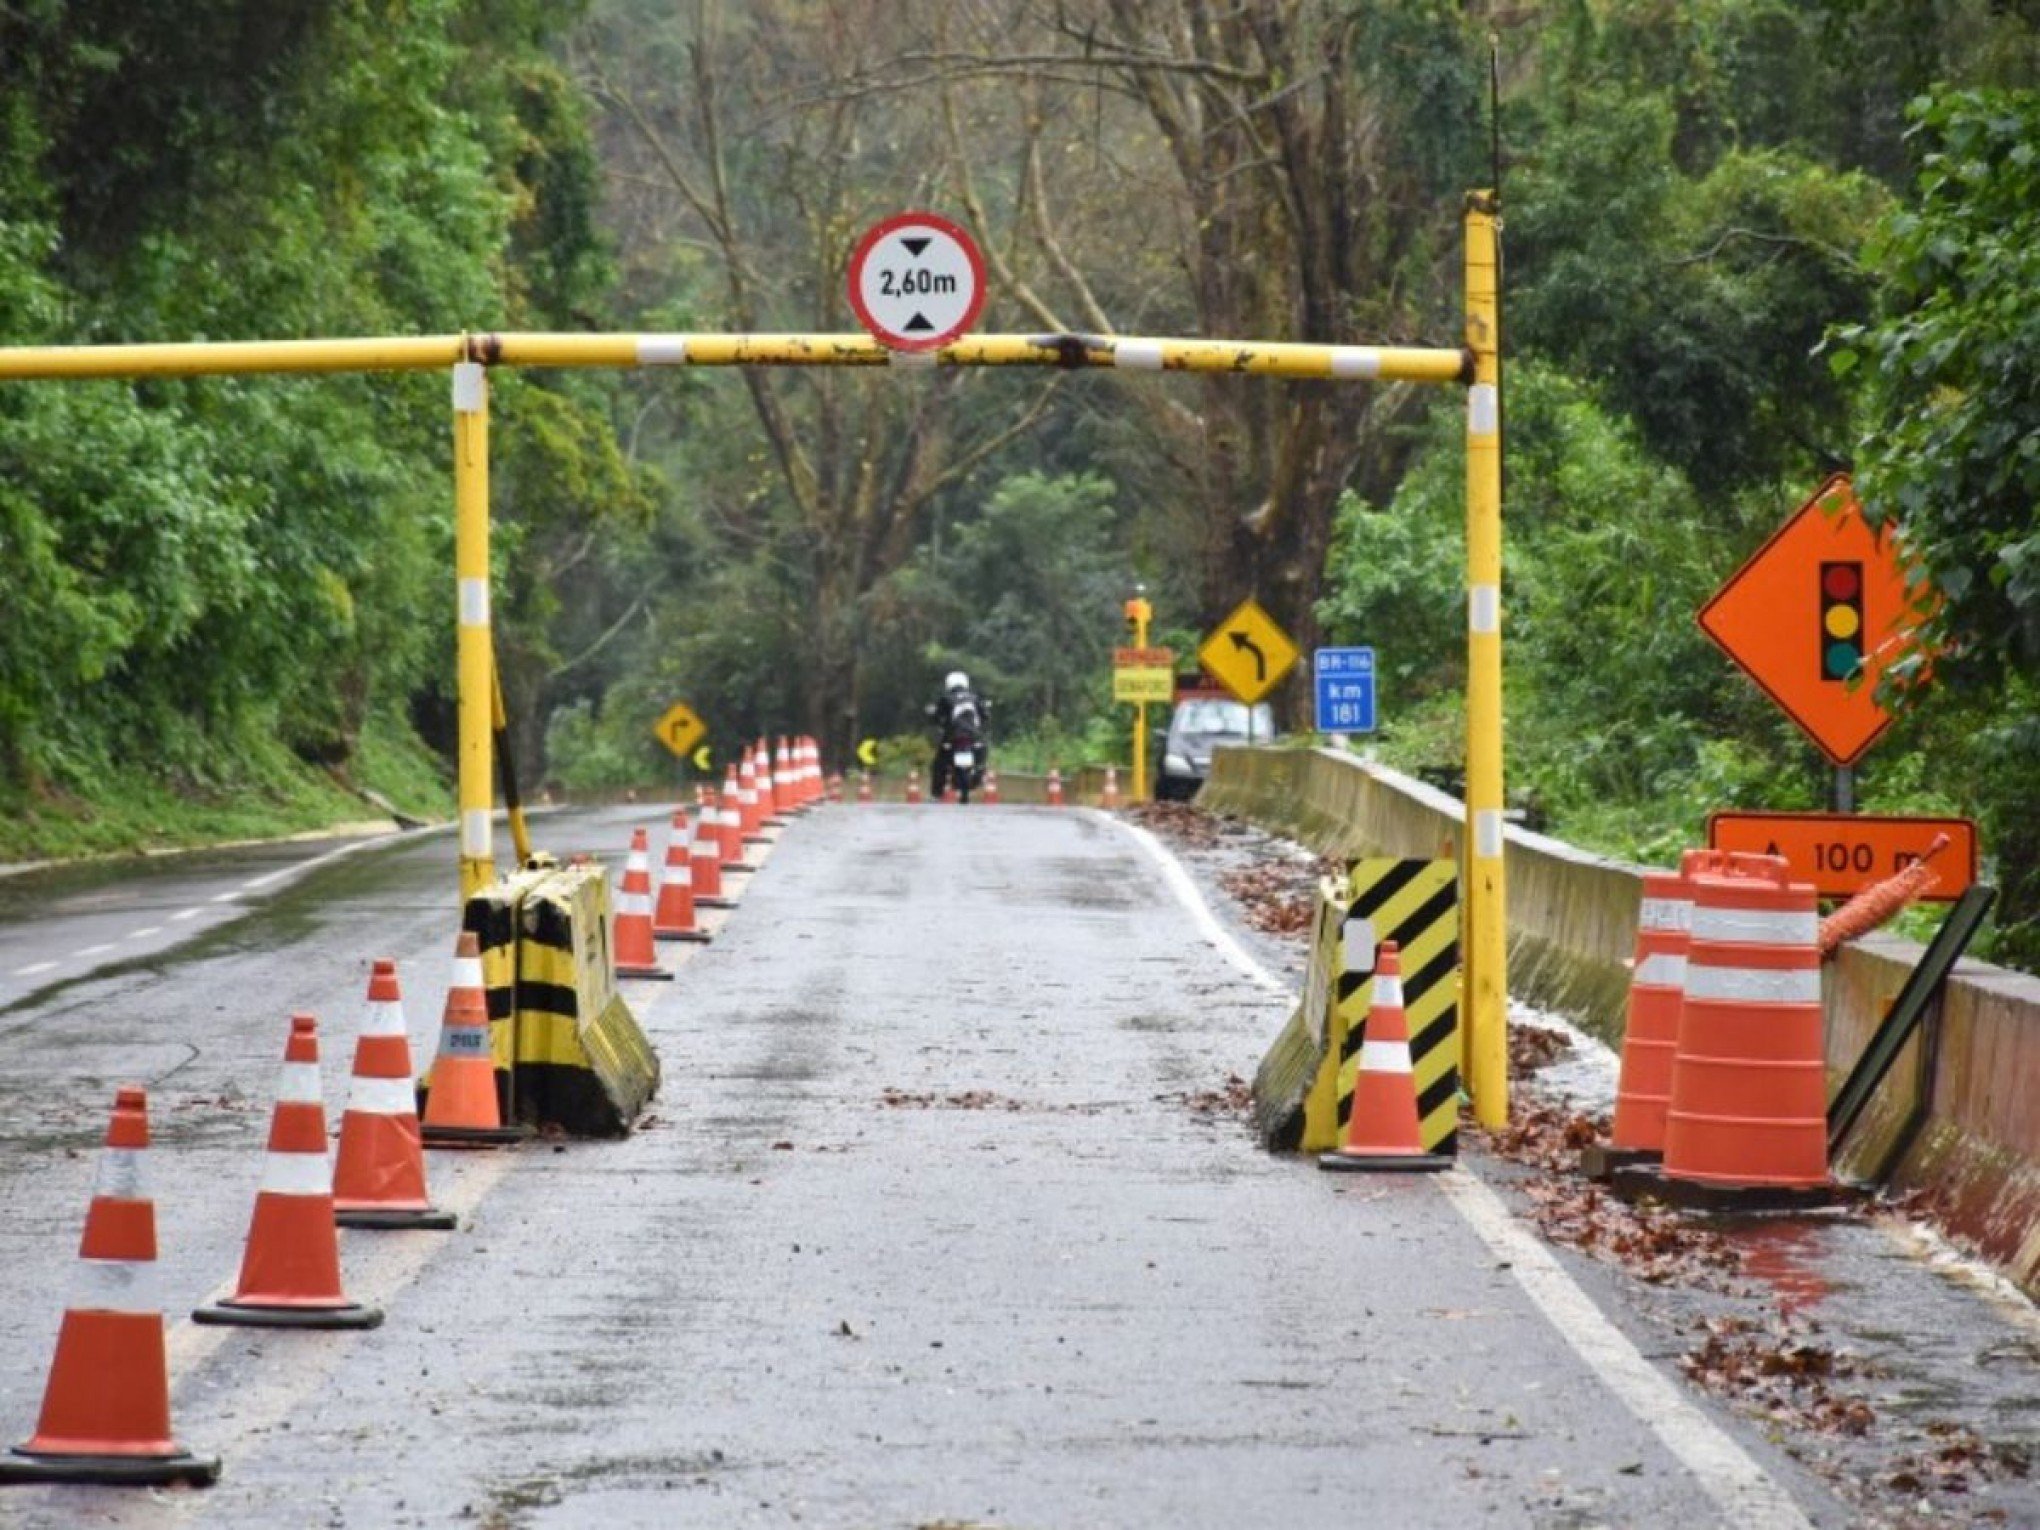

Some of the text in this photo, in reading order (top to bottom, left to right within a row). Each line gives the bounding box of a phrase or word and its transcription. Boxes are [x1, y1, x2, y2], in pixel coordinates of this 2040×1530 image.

[880, 268, 956, 298] 2,60m
[1329, 682, 1361, 698] km
[1814, 843, 1873, 872] 100
